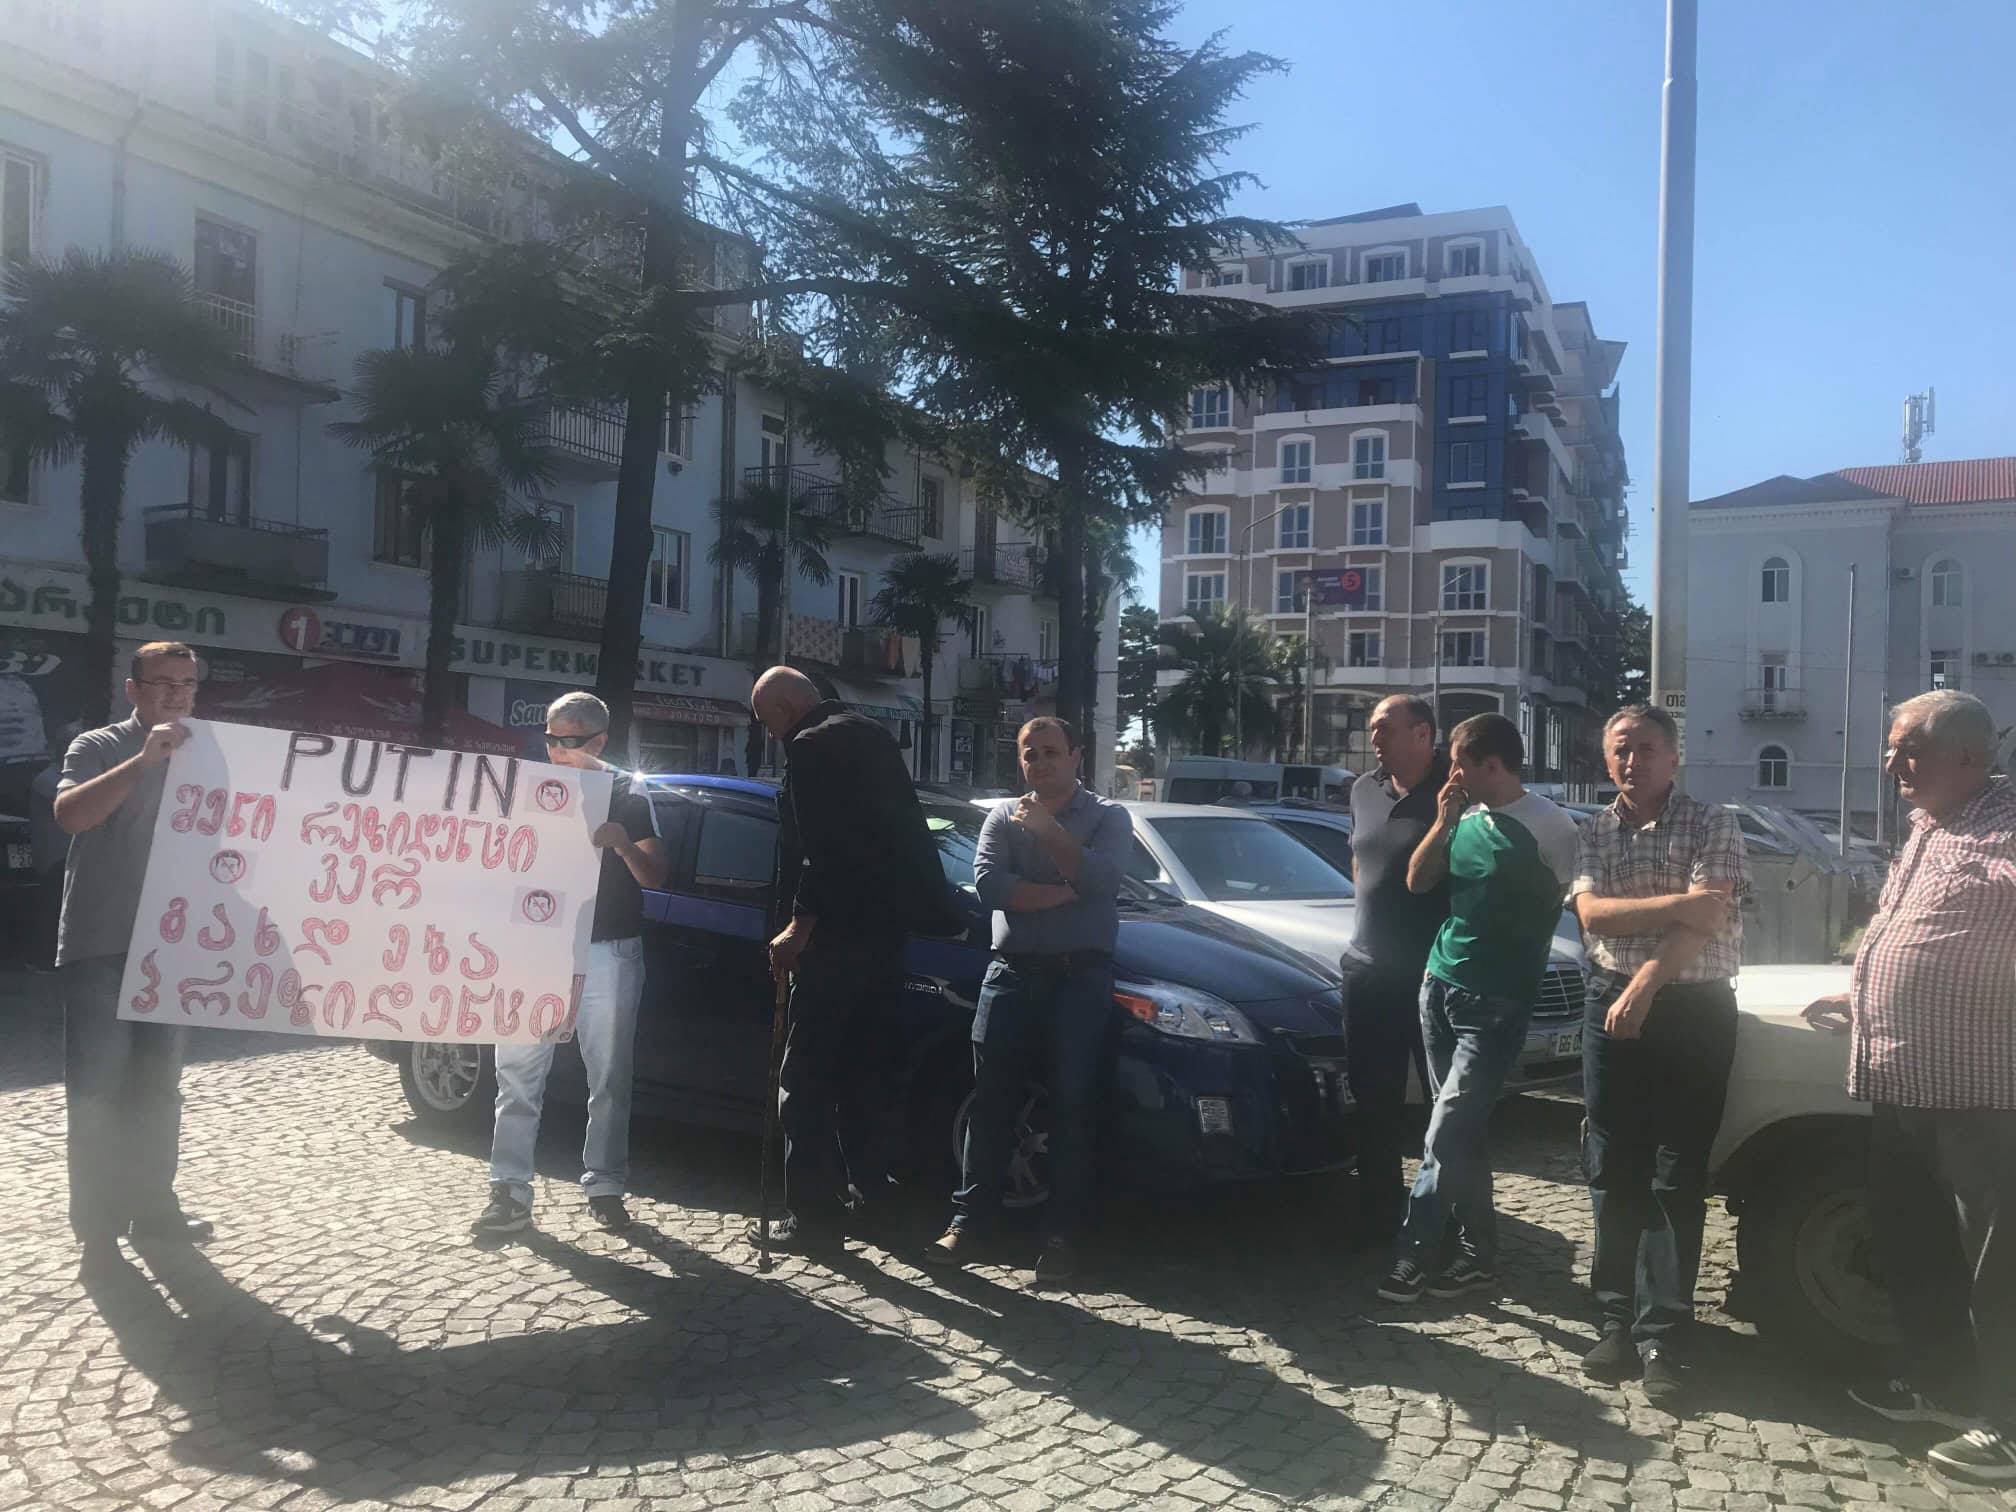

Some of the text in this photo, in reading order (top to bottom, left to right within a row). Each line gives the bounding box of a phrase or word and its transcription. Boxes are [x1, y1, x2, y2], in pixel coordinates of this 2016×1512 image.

[0, 577, 226, 636] არეტი
[450, 636, 707, 688] SUPERMRKET
[280, 731, 521, 819] PUTIN
